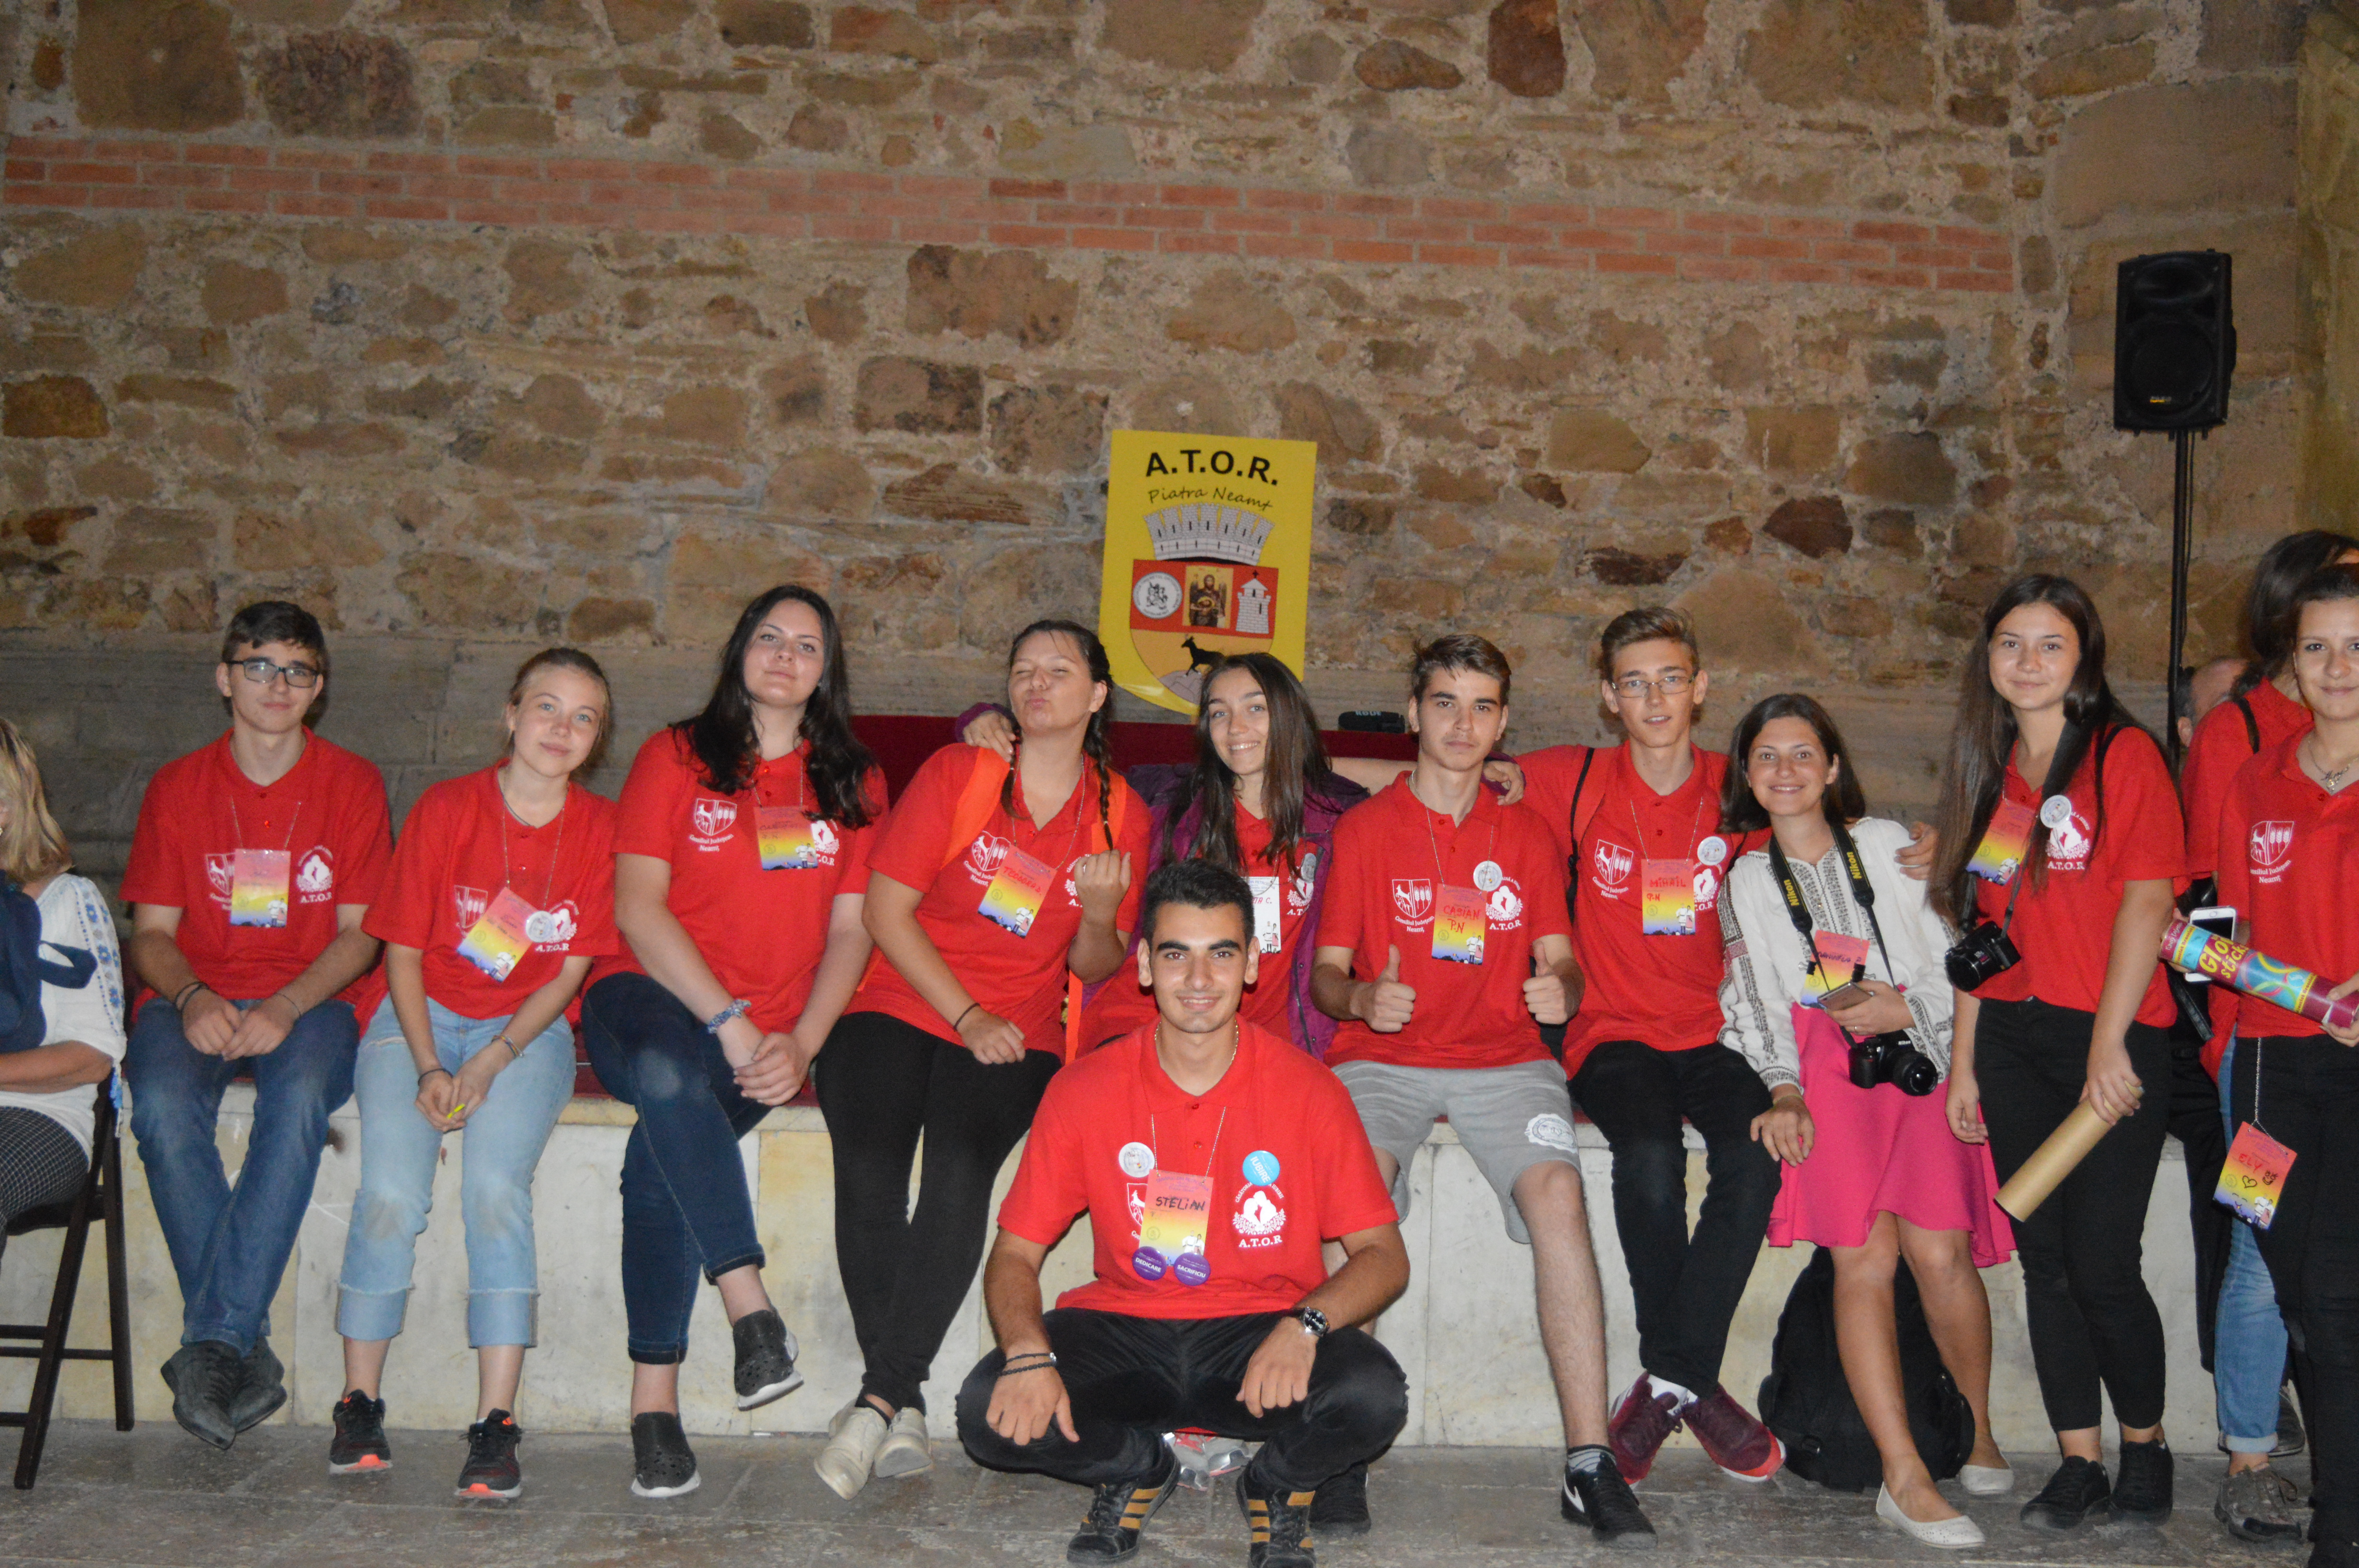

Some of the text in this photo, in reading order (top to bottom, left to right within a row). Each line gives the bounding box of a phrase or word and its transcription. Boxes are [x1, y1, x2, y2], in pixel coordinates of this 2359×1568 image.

[1146, 450, 1278, 486] A.T.O.R.
[1148, 486, 1208, 503] Piatra
[1847, 852, 1862, 879] Nikon
[1784, 879, 1799, 906] Nikon
[1395, 916, 1414, 926] Consiliul
[1489, 919, 1522, 930] A.T.O.R
[1250, 1156, 1271, 1183] IUBIRE
[1239, 1235, 1283, 1248] A.T.O.R
[1135, 1257, 1161, 1272] DEDICARE
[1177, 1265, 1206, 1278] SACRIFICIU
